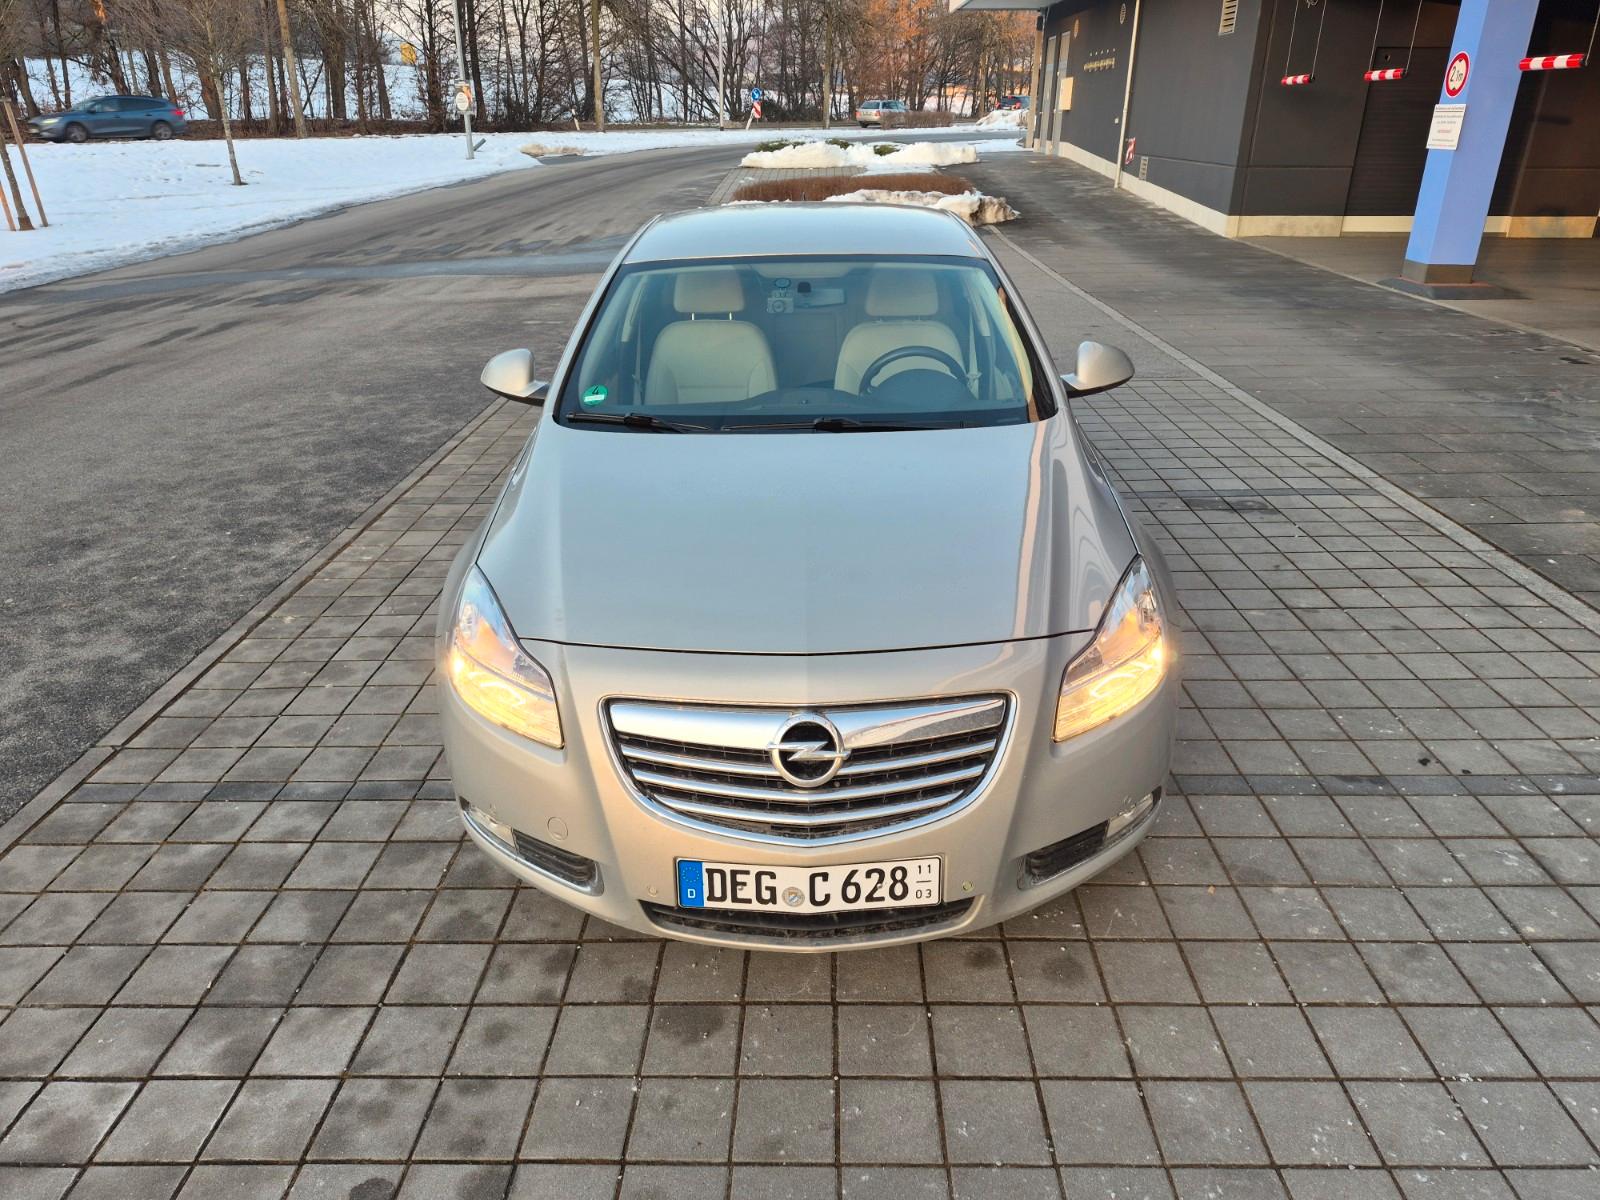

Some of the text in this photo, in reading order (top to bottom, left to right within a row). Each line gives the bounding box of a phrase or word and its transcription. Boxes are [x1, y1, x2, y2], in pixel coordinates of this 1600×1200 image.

[592, 385, 599, 395] 4
[917, 864, 931, 875] 11
[705, 865, 909, 907] DEG C 628
[687, 888, 696, 899] D
[915, 889, 932, 899] 03
